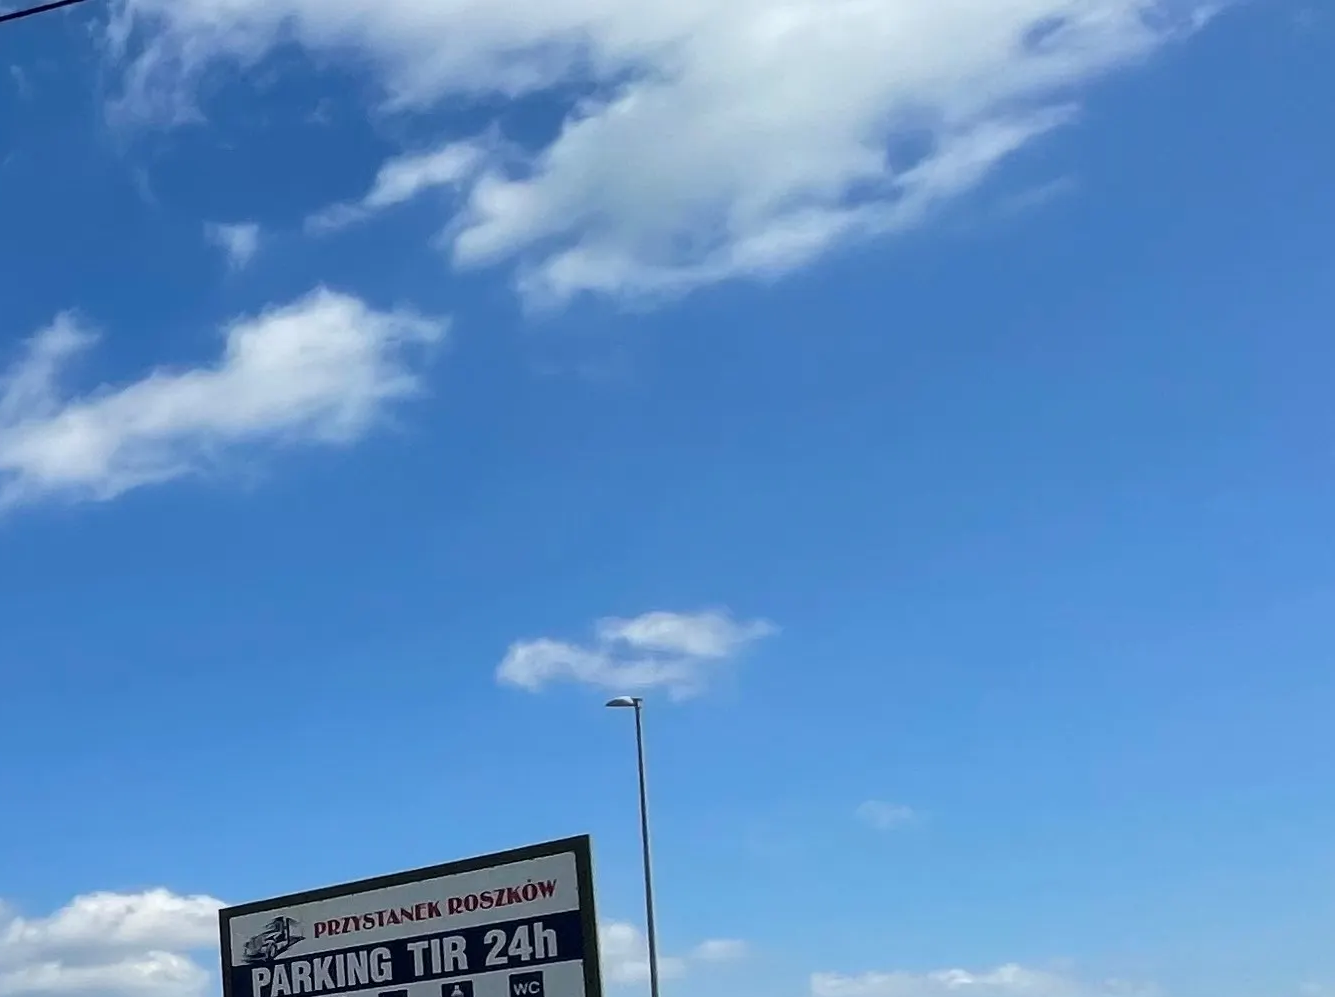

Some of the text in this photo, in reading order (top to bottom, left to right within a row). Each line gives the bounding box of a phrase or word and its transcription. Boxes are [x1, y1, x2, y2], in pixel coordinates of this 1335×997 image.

[313, 879, 557, 938] PRZYSTANEK ROSZKÓW
[407, 935, 468, 977] TIR
[483, 922, 557, 967] 24h
[513, 981, 540, 996] WC
